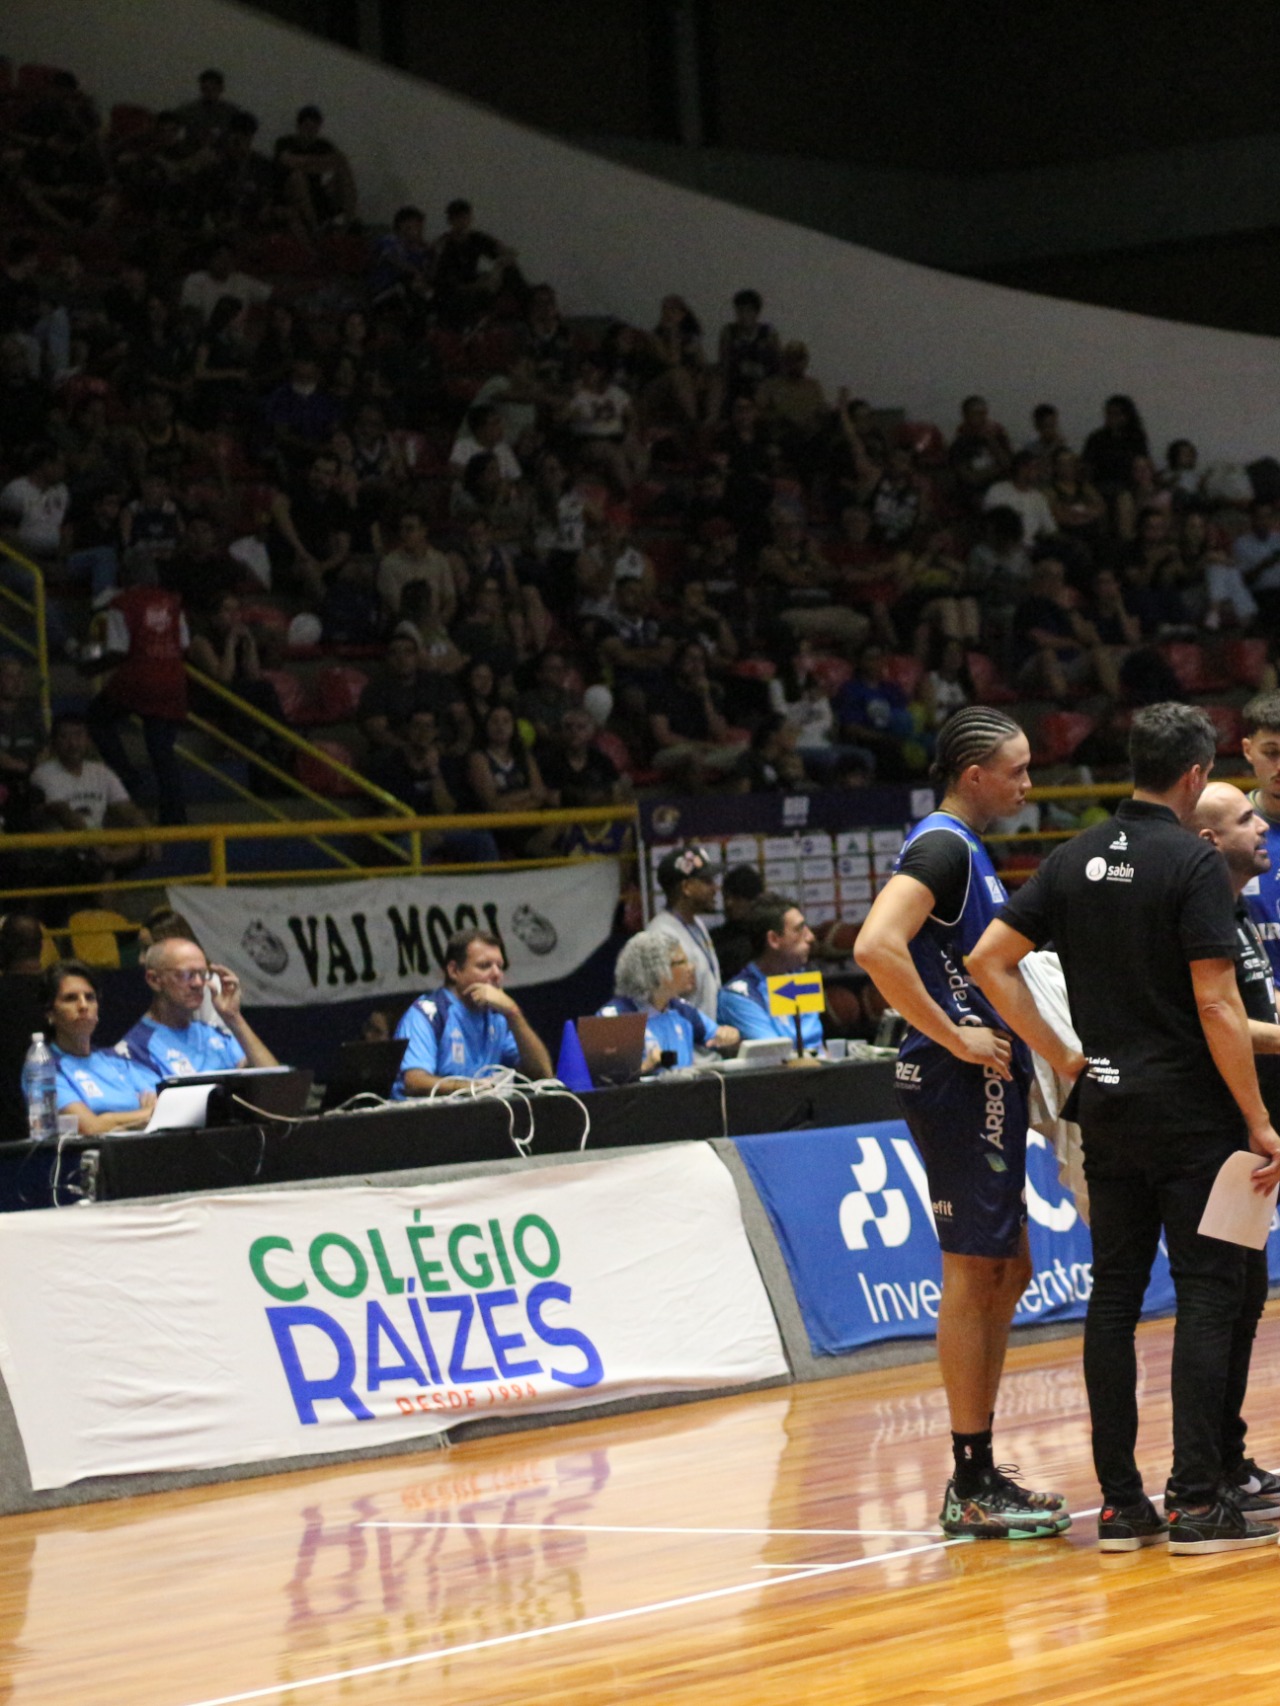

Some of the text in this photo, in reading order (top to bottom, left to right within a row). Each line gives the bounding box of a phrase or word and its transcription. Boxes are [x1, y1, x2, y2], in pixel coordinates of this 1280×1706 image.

[1107, 861, 1134, 878] sabin
[288, 913, 377, 988] VAI
[248, 1208, 561, 1302] COLÉGIO
[264, 1276, 605, 1425] RAÍZES
[395, 1383, 539, 1416] DESDE 1994
